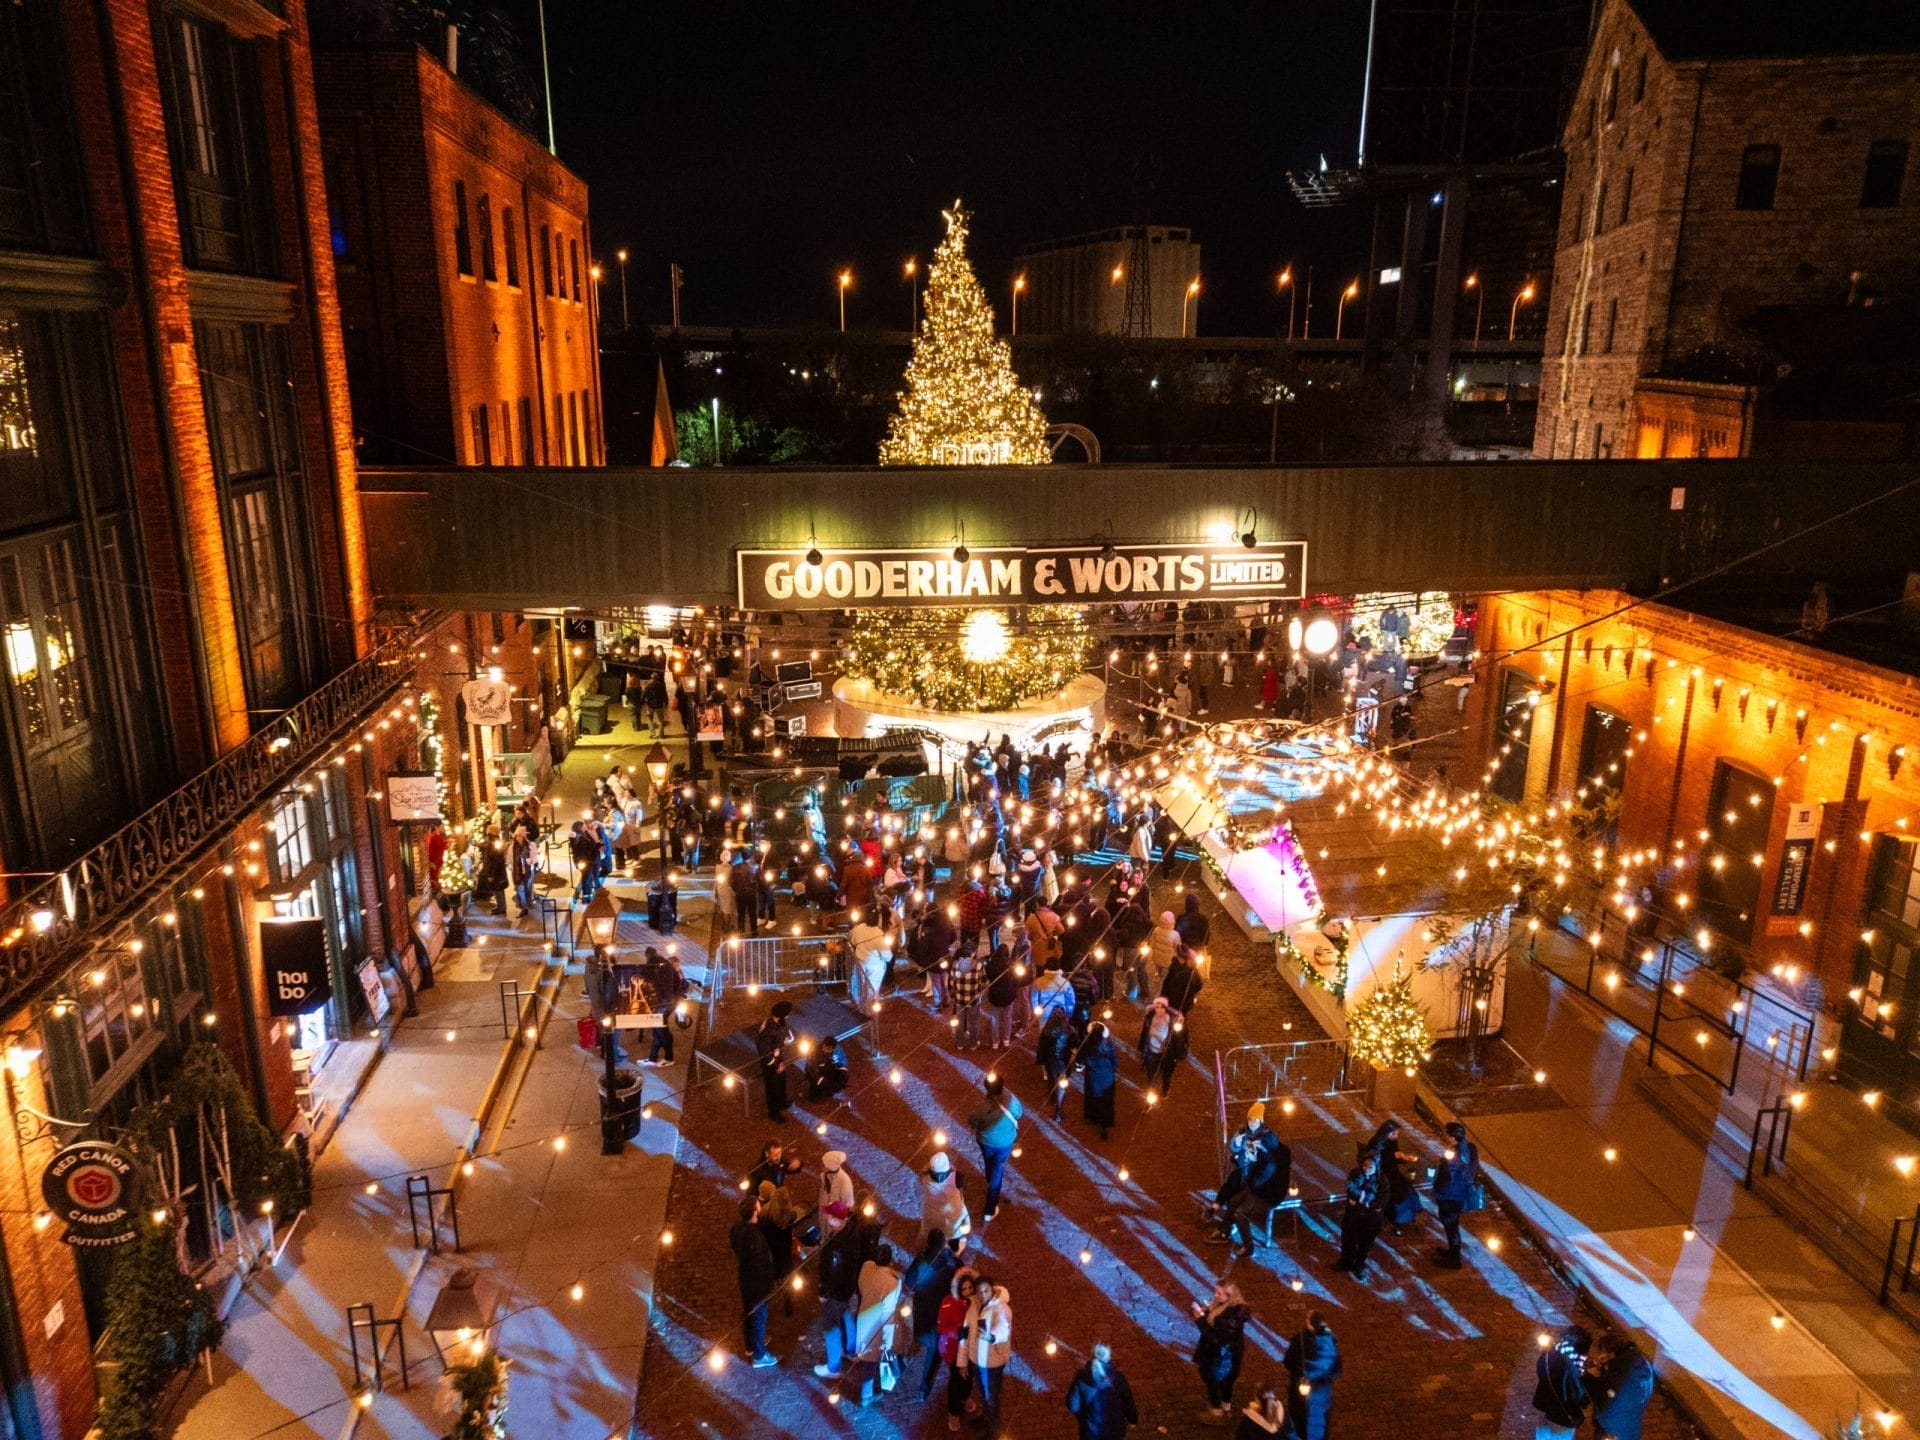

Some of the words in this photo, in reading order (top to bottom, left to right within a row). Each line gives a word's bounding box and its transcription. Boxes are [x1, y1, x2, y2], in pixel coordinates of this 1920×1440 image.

[764, 559, 1022, 599] GOODERHAM
[1033, 557, 1067, 596] &
[1071, 555, 1206, 594] WORTS
[1210, 560, 1284, 583] LIMITED
[1778, 868, 1793, 910] GALLERY
[1786, 845, 1807, 910] CONTEMPORARY
[280, 985, 305, 1000] bo
[51, 1154, 78, 1177] RED
[79, 1151, 130, 1174] CANOE
[68, 1208, 127, 1224] CANADA
